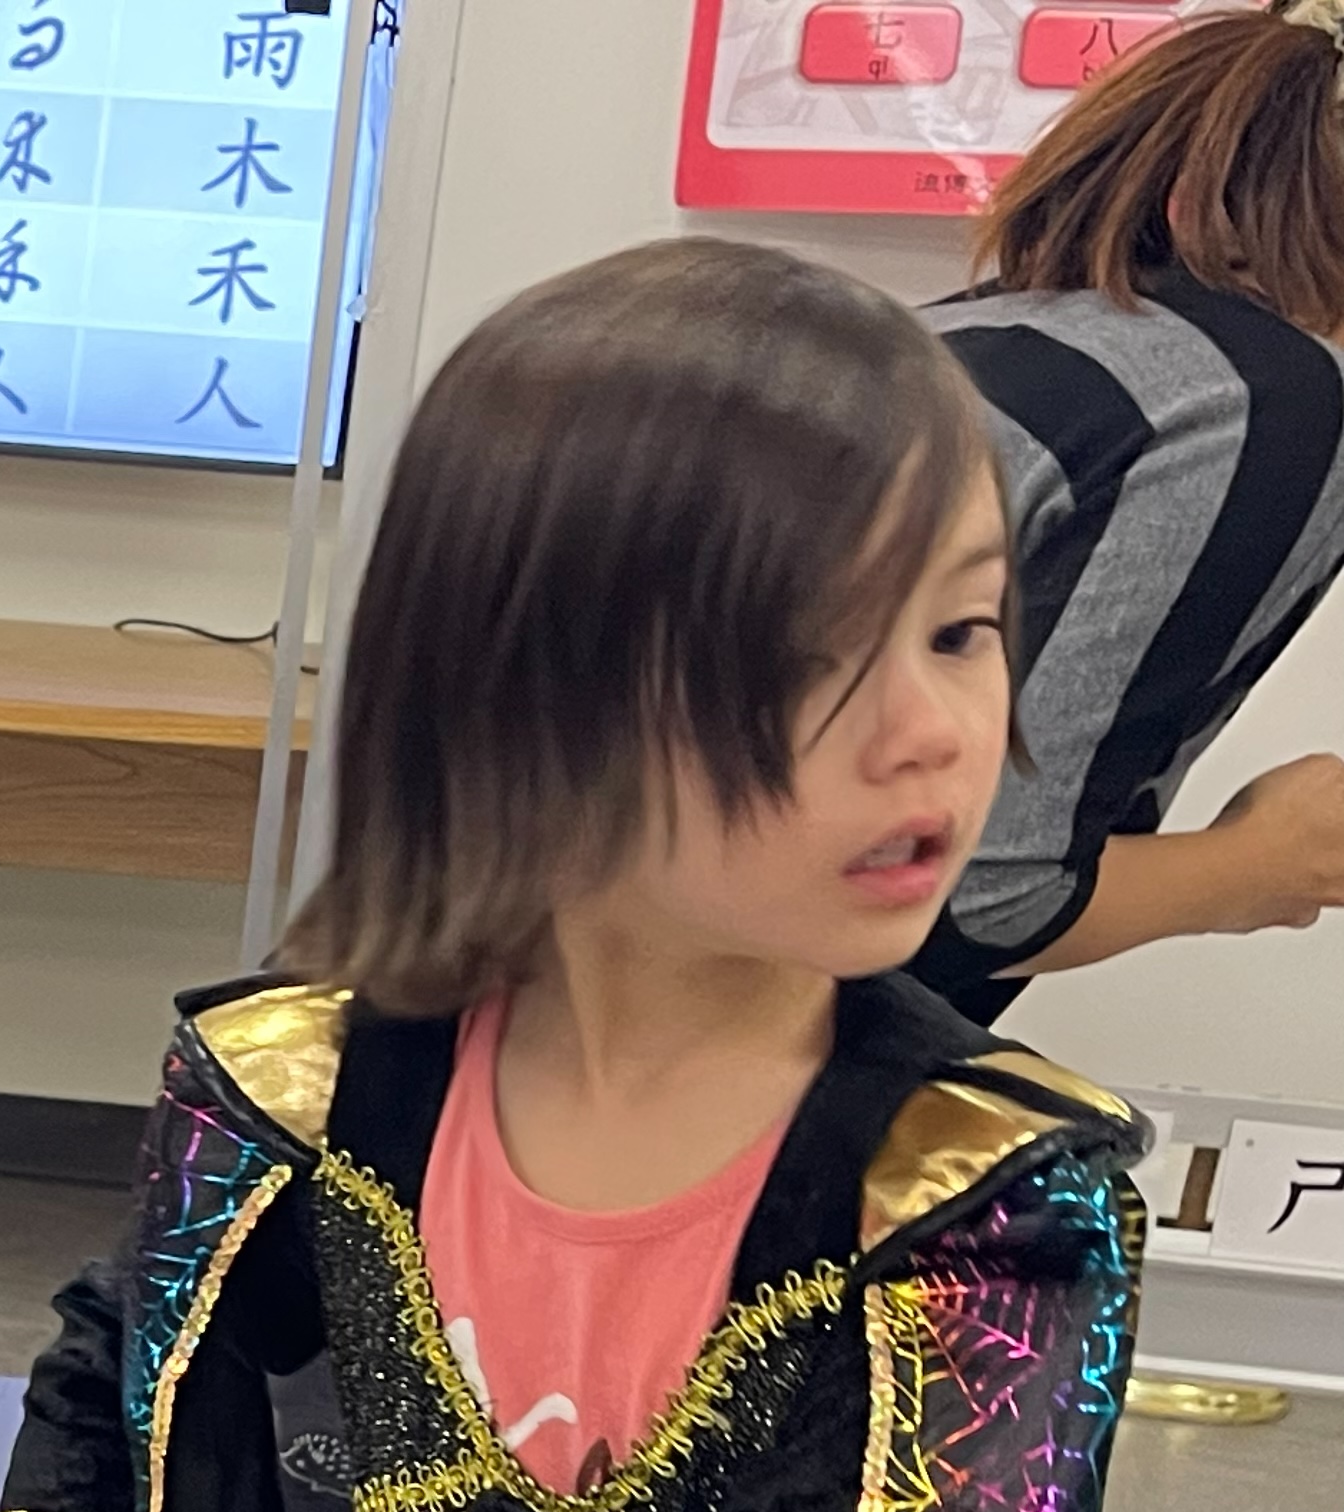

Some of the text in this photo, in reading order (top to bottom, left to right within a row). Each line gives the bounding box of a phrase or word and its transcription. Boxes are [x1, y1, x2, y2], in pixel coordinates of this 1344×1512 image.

[223, 12, 304, 90] 雨
[864, 11, 905, 49] 七
[1080, 18, 1118, 55] 八
[200, 118, 293, 208] 木
[188, 238, 276, 325] 禾
[174, 357, 262, 429] 人
